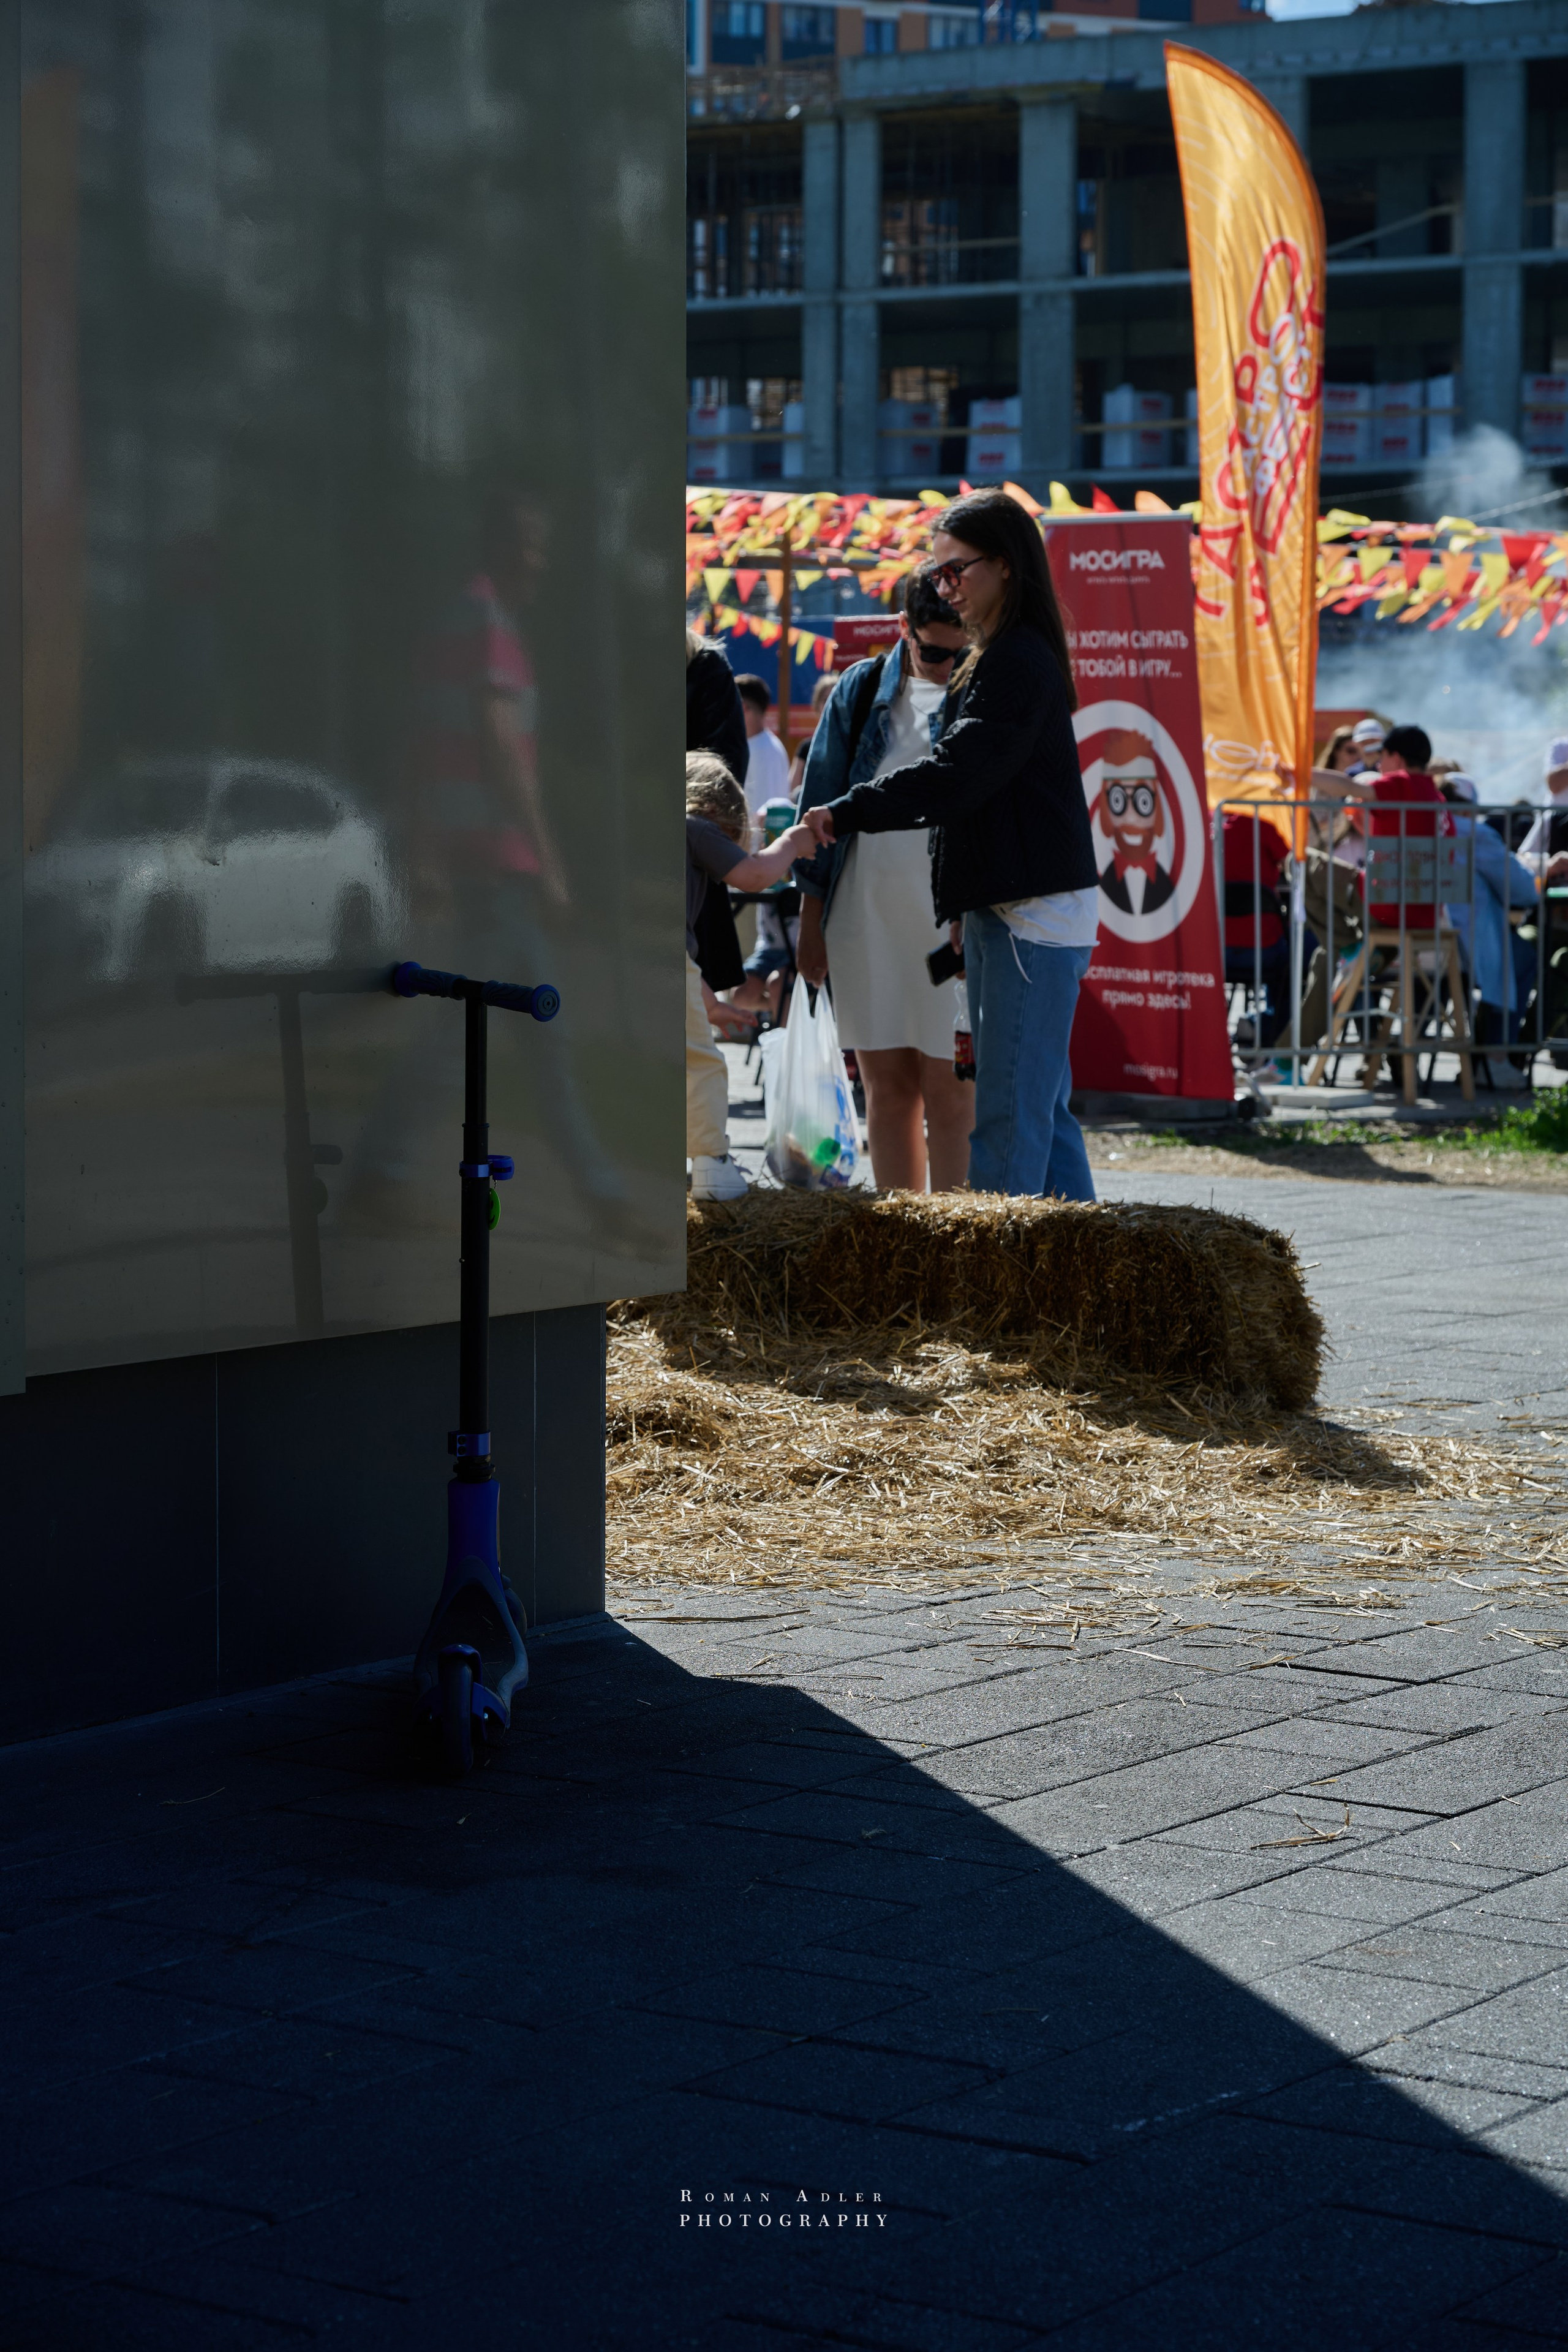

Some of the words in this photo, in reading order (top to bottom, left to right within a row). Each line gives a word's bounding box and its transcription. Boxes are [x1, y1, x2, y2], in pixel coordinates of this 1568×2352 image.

[1069, 550, 1165, 571] МОСИГРА
[1079, 630, 1129, 649] ХОТИМ
[1131, 630, 1189, 649] СЫГРАТЬ
[1077, 655, 1126, 678] ТОБОЙ
[1128, 660, 1138, 678] В
[1153, 970, 1215, 990] игротека
[1102, 989, 1145, 1009] прямо
[1147, 990, 1191, 1010] здесь!
